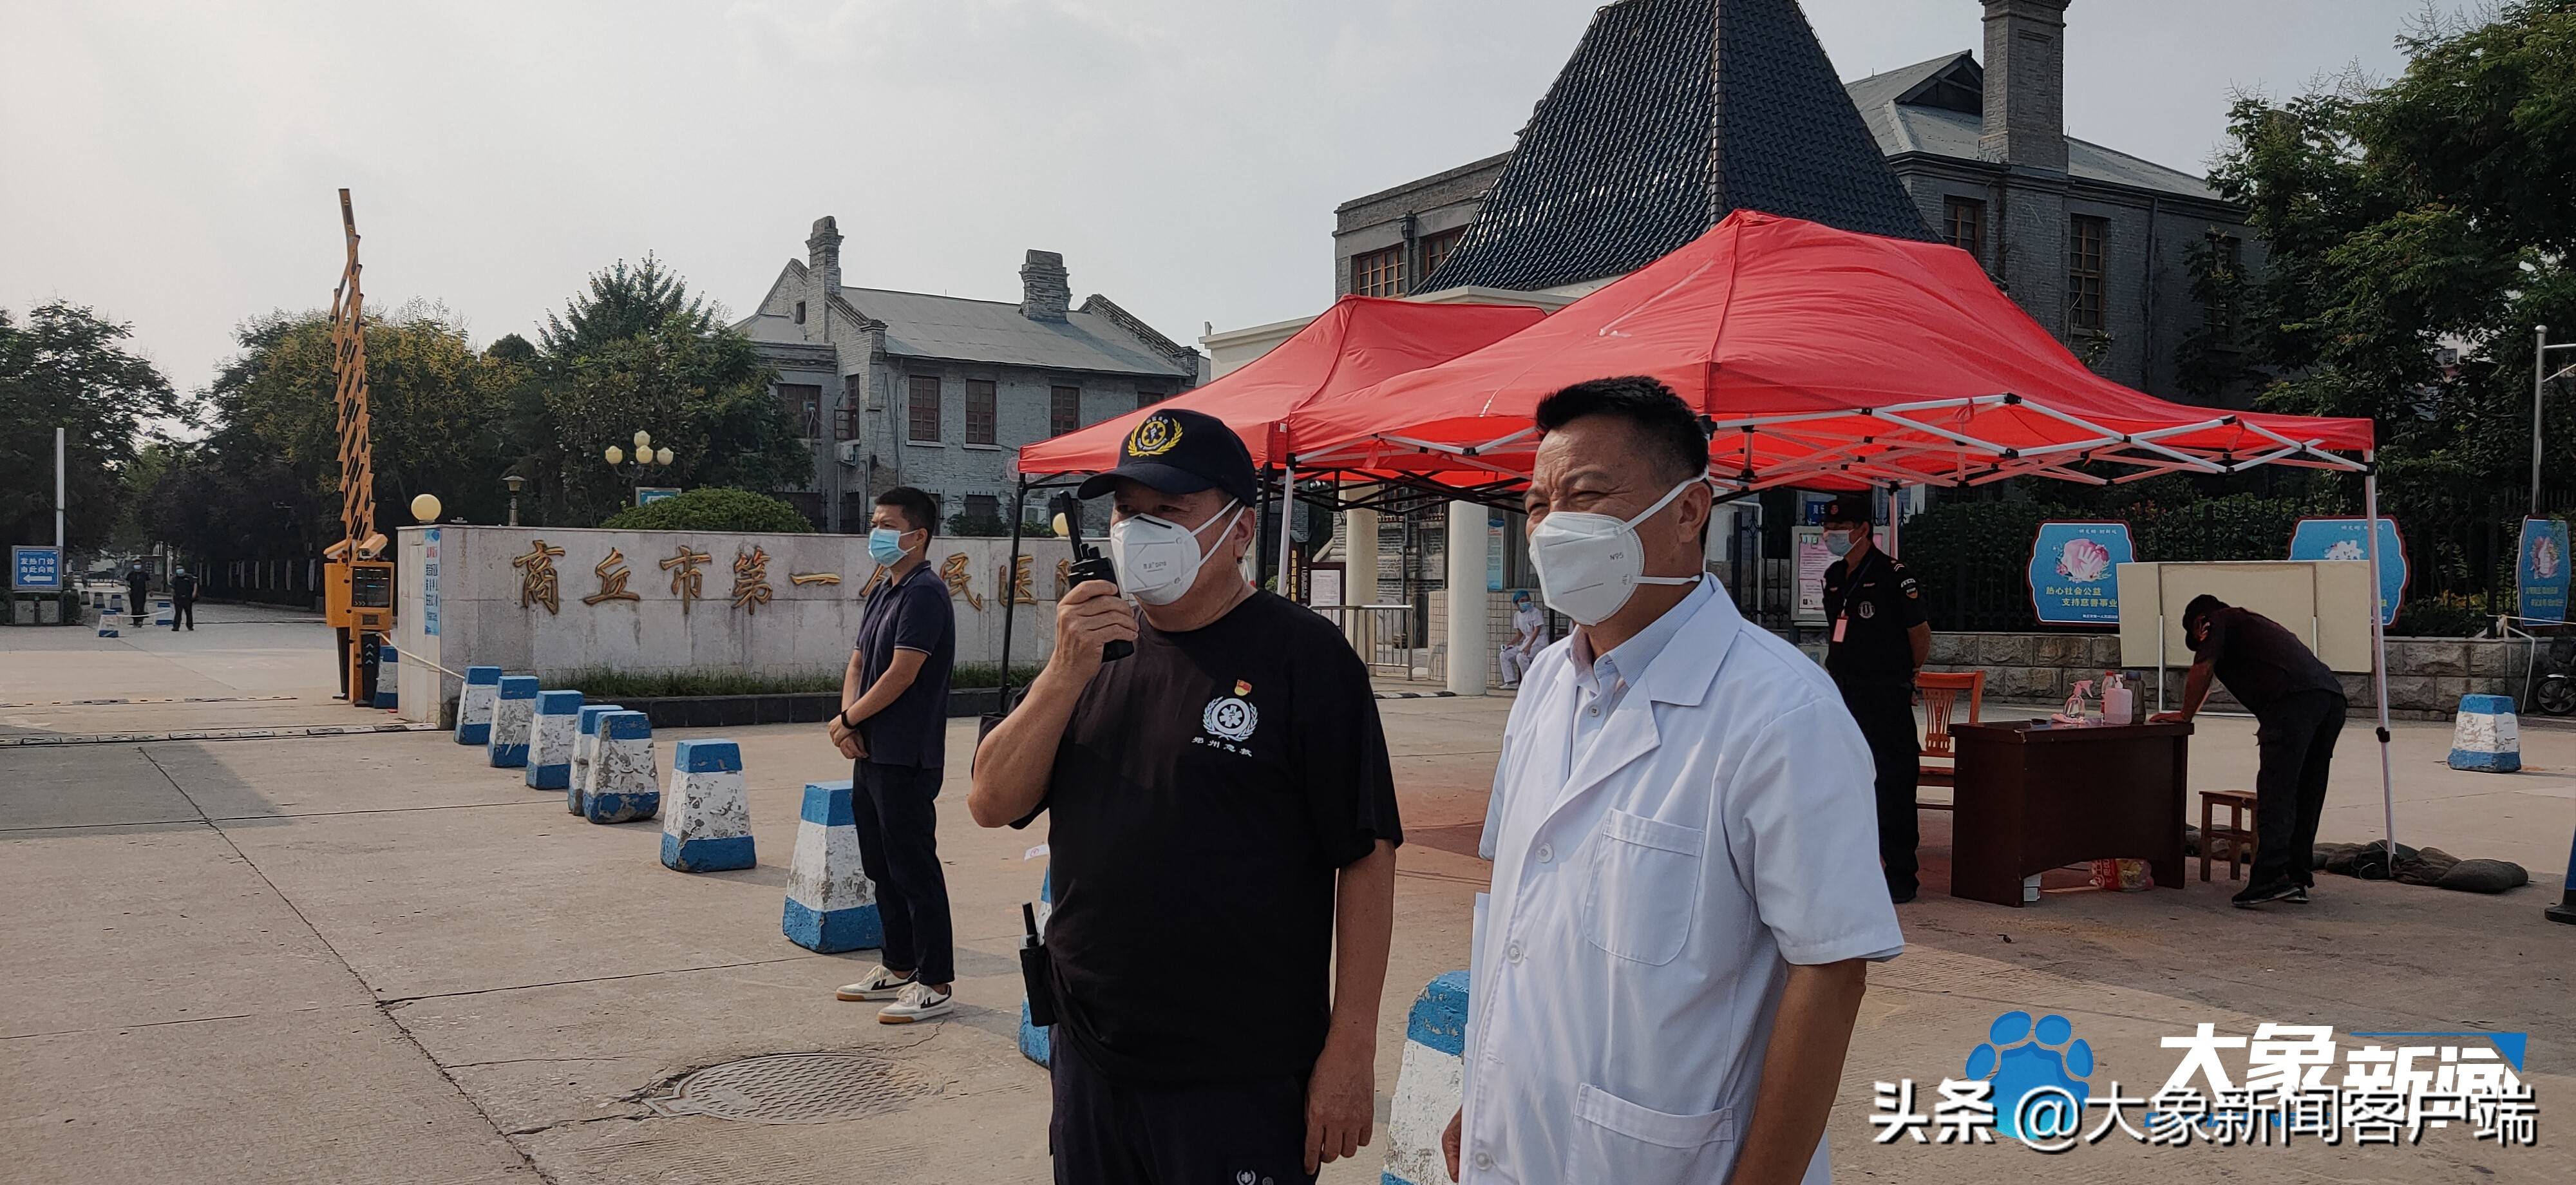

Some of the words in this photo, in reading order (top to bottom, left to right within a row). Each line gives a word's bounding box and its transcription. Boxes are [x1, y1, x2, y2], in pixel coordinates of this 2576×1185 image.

[2046, 586, 2102, 596] 热心社会公益
[2061, 598, 2117, 607] 支持慈善事业
[1191, 736, 1253, 757] 郑州急救
